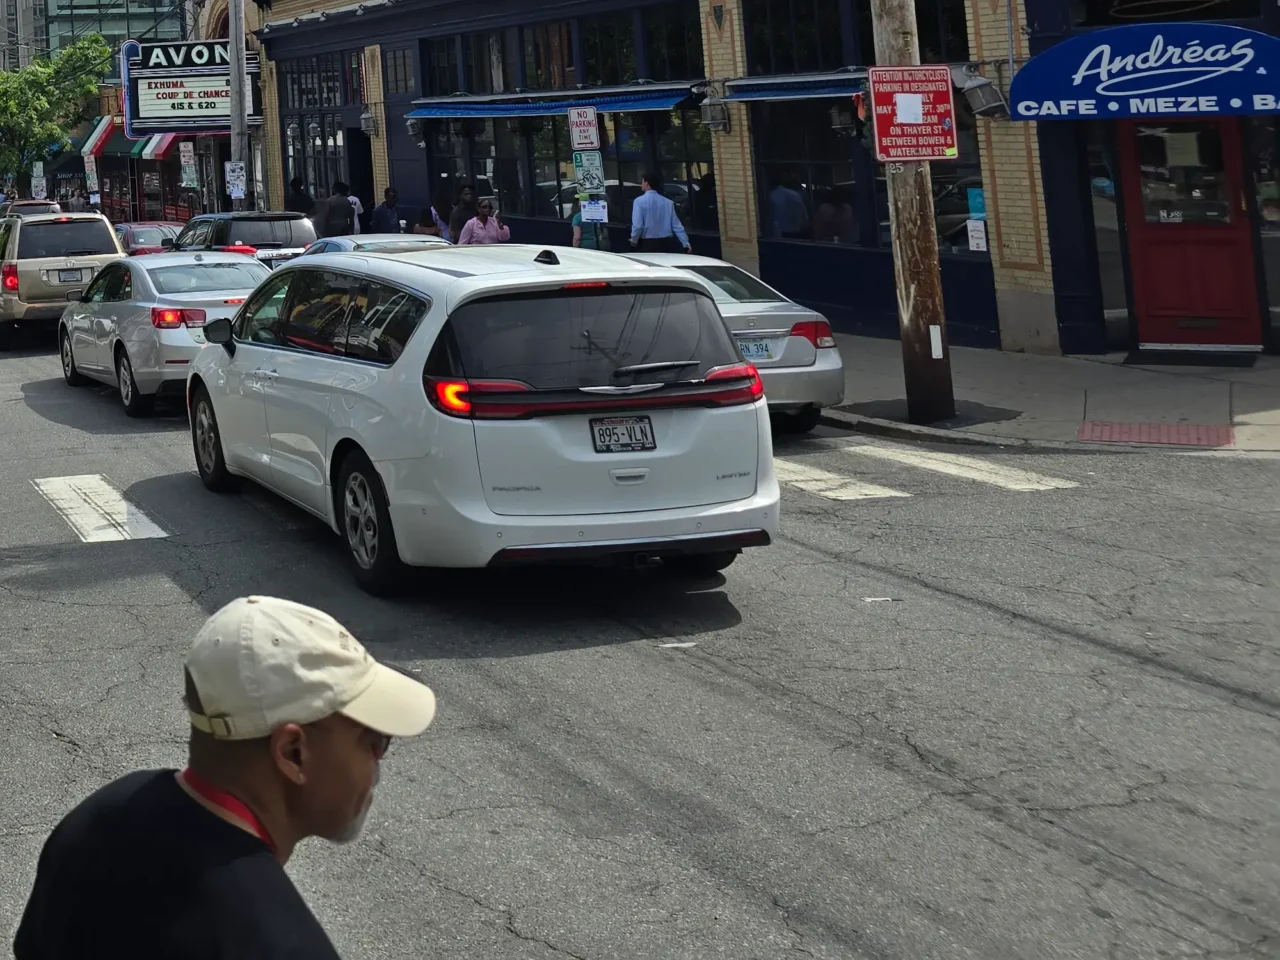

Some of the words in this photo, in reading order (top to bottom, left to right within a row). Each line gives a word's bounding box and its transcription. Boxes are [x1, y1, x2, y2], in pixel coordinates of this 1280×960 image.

[148, 44, 231, 67] AVON
[1072, 34, 1255, 96] Andréas
[872, 71, 901, 81] ATTENTION
[903, 70, 947, 80] MOTORCYCLISTS
[147, 80, 185, 89] EXHUMA
[875, 82, 902, 92] PARKING
[903, 82, 909, 92] IN
[911, 82, 947, 91] DESIGNATED
[156, 91, 179, 99] COUP
[183, 91, 194, 99] DE
[198, 90, 231, 98] CHANCE
[170, 102, 185, 110] 415
[198, 101, 216, 109] 620
[876, 105, 892, 114] MAY
[1017, 99, 1098, 116] CAFE
[1129, 96, 1220, 113] MEZE
[576, 111, 588, 119] NO
[571, 120, 596, 128] PARKING
[890, 126, 901, 135] ON
[903, 126, 931, 135] THAYER
[933, 125, 943, 133] ST
[882, 137, 917, 146] BETWEEN
[918, 136, 945, 145] BOWEN
[946, 136, 952, 144] &
[575, 154, 581, 162] 3
[753, 343, 769, 353] 394
[597, 425, 649, 443] 895-VLN
